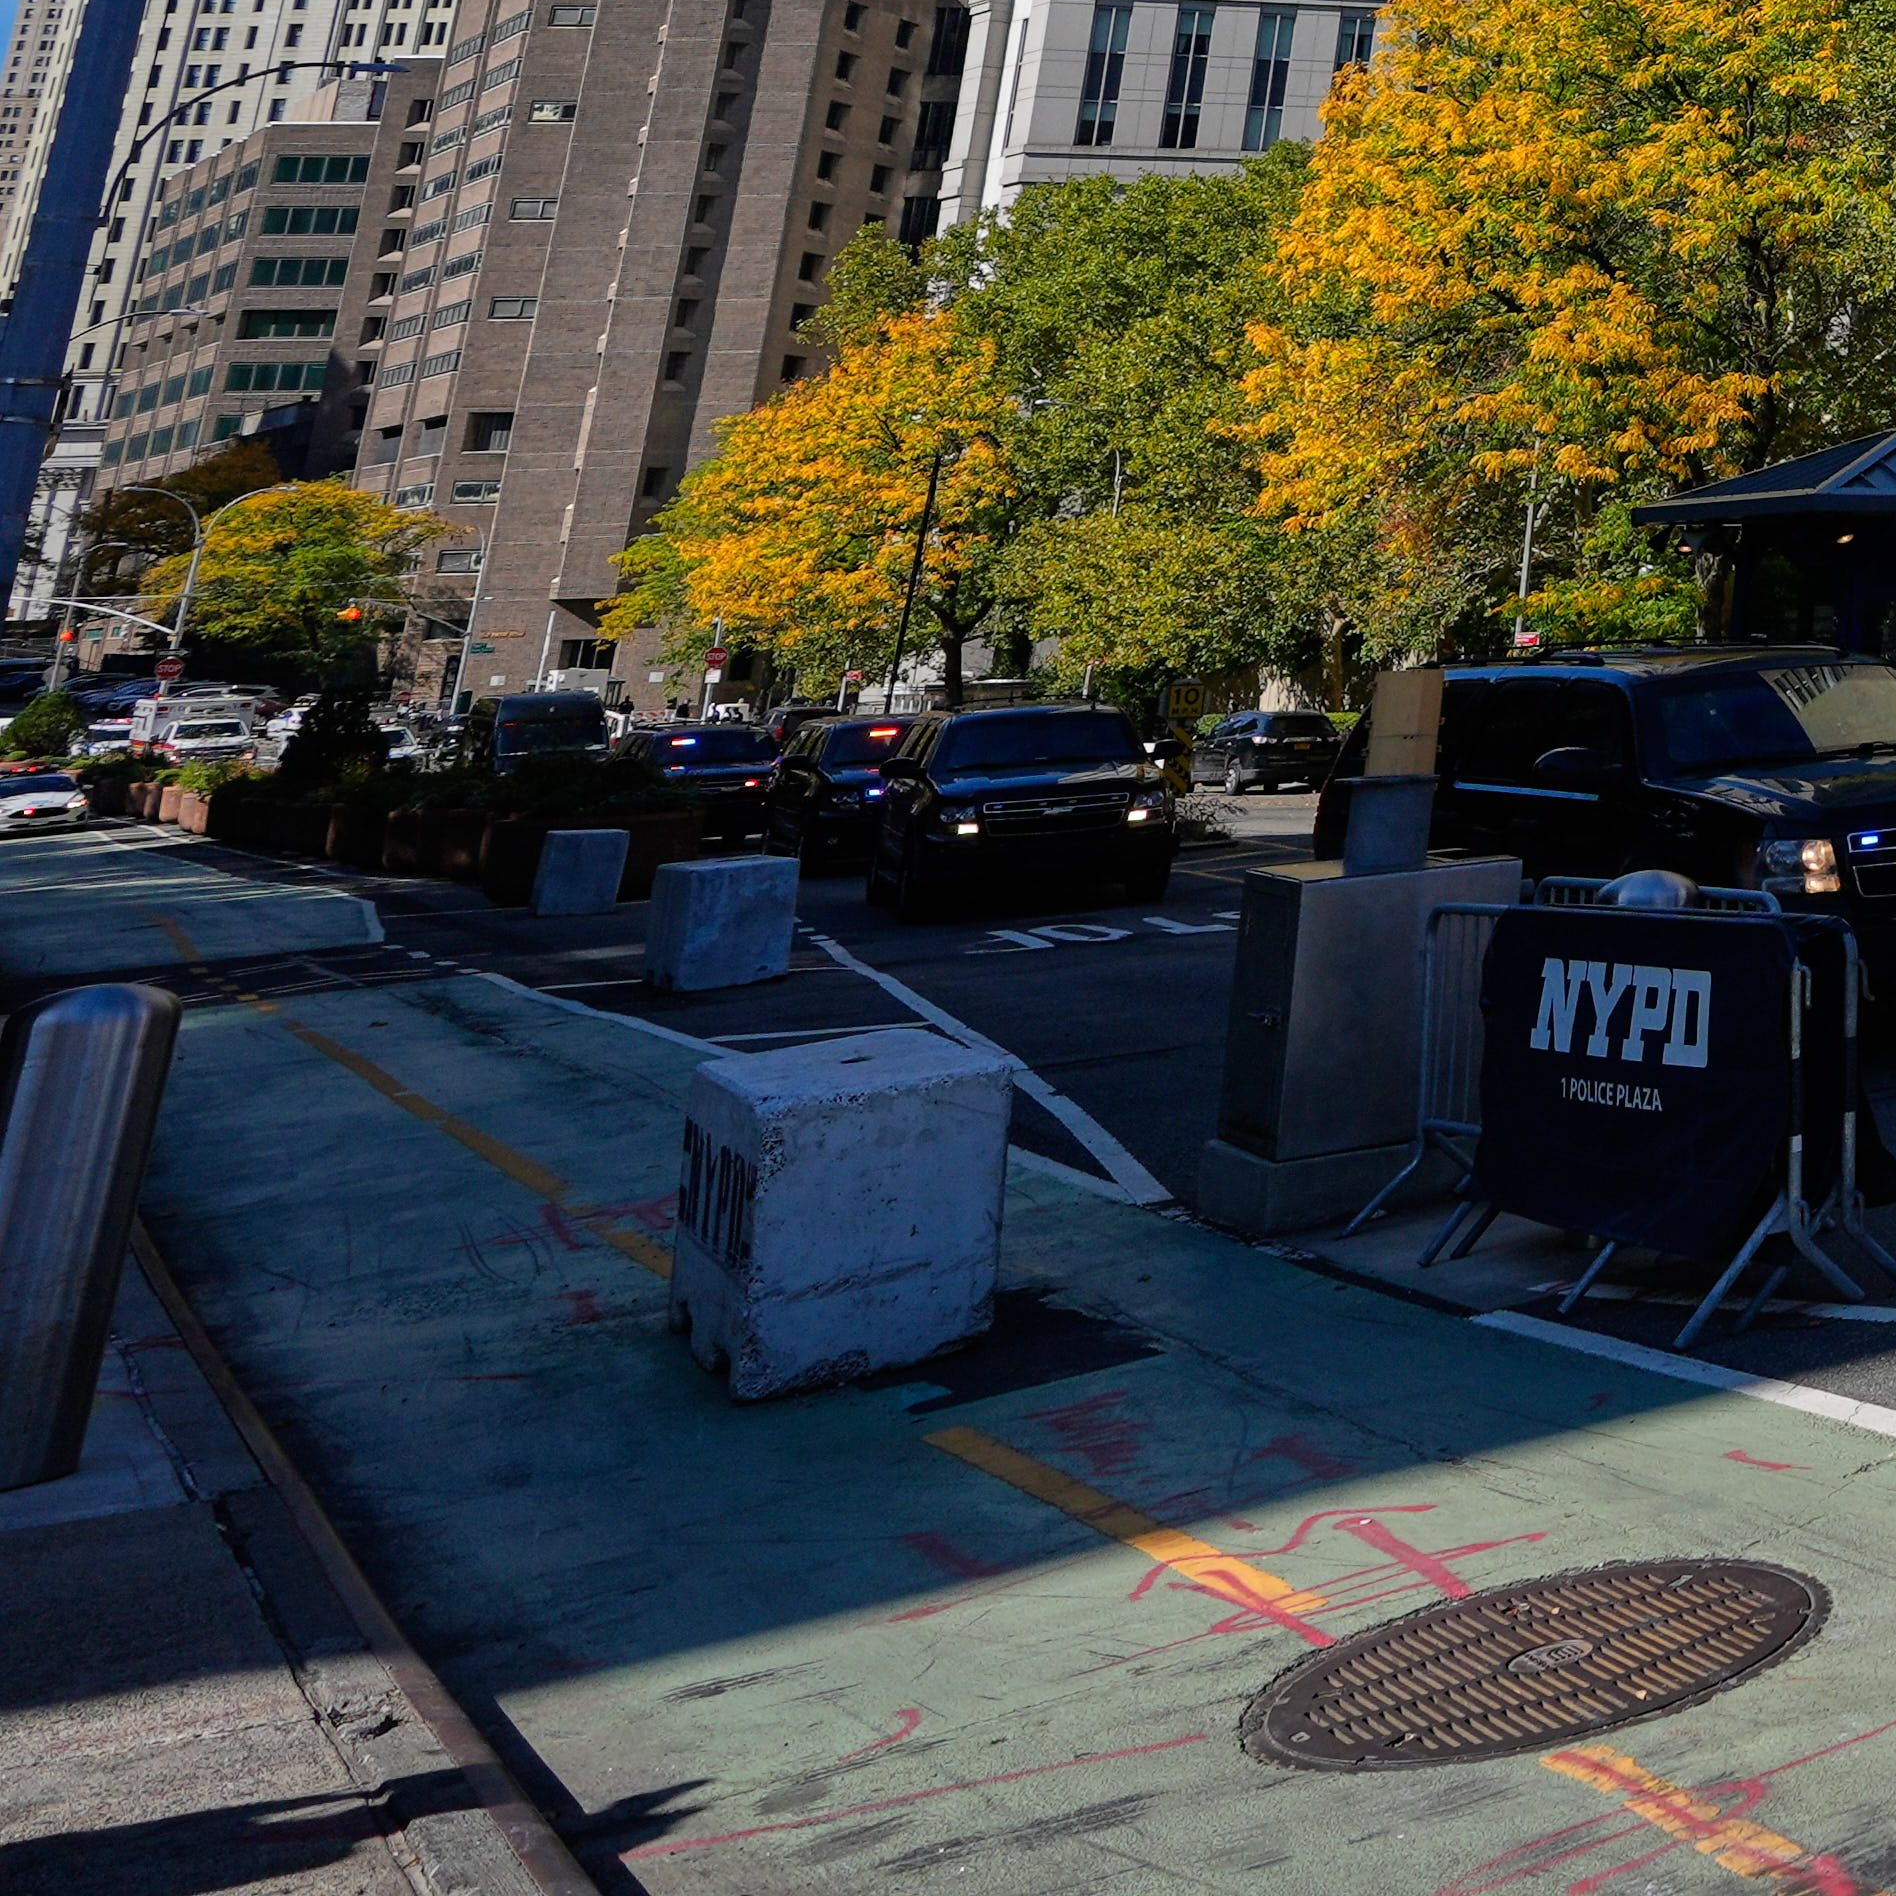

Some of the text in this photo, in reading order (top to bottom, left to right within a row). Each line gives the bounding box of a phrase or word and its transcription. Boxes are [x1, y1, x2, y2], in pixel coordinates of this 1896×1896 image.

[707, 652, 727, 661] STOP
[158, 664, 183, 673] STOP
[1175, 689, 1199, 704] 10
[1529, 957, 1712, 1069] NYPD
[1560, 1077, 1663, 1113] 1 POLICE PLAZA
